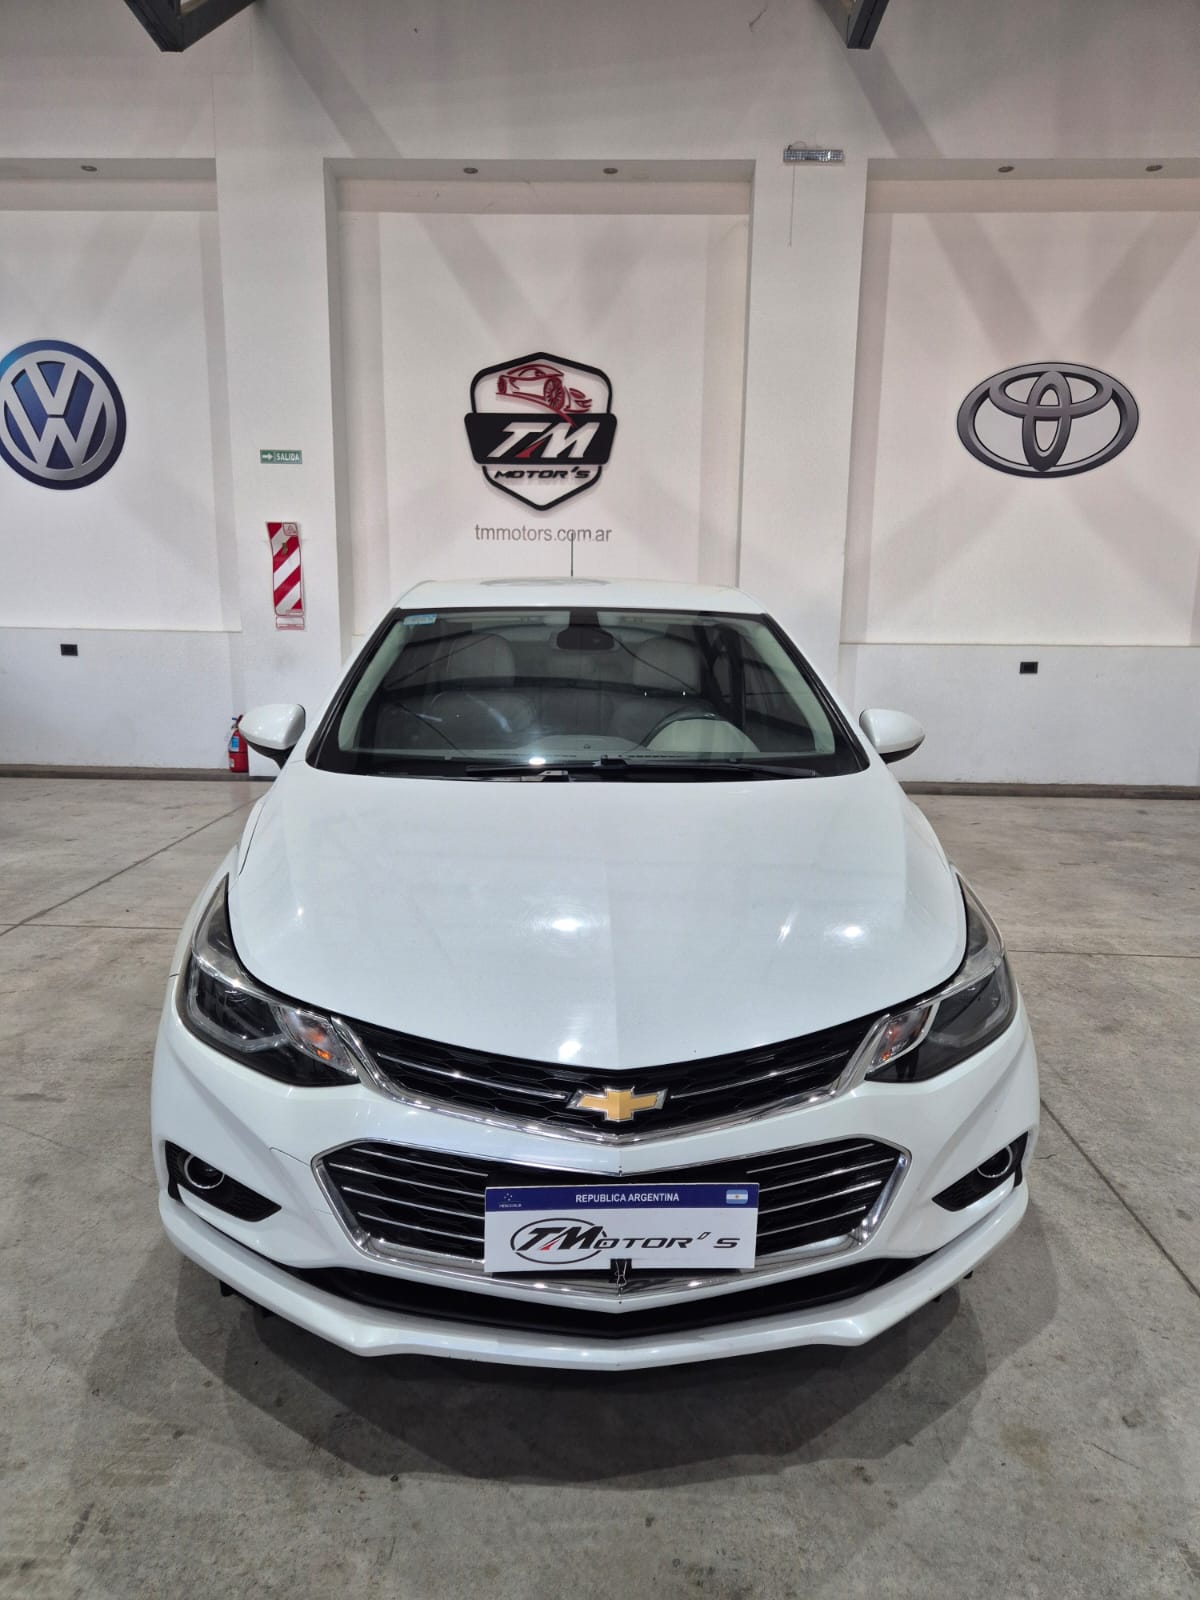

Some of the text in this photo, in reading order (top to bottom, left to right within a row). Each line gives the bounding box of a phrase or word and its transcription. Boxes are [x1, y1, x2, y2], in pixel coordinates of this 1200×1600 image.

[487, 421, 601, 459] TM
[276, 452, 300, 461] SALIDA
[494, 466, 591, 479] MOTOR'S
[475, 524, 613, 542] tmmotors.com.ar
[575, 1192, 680, 1203] REPUBLICA ARGENTINA
